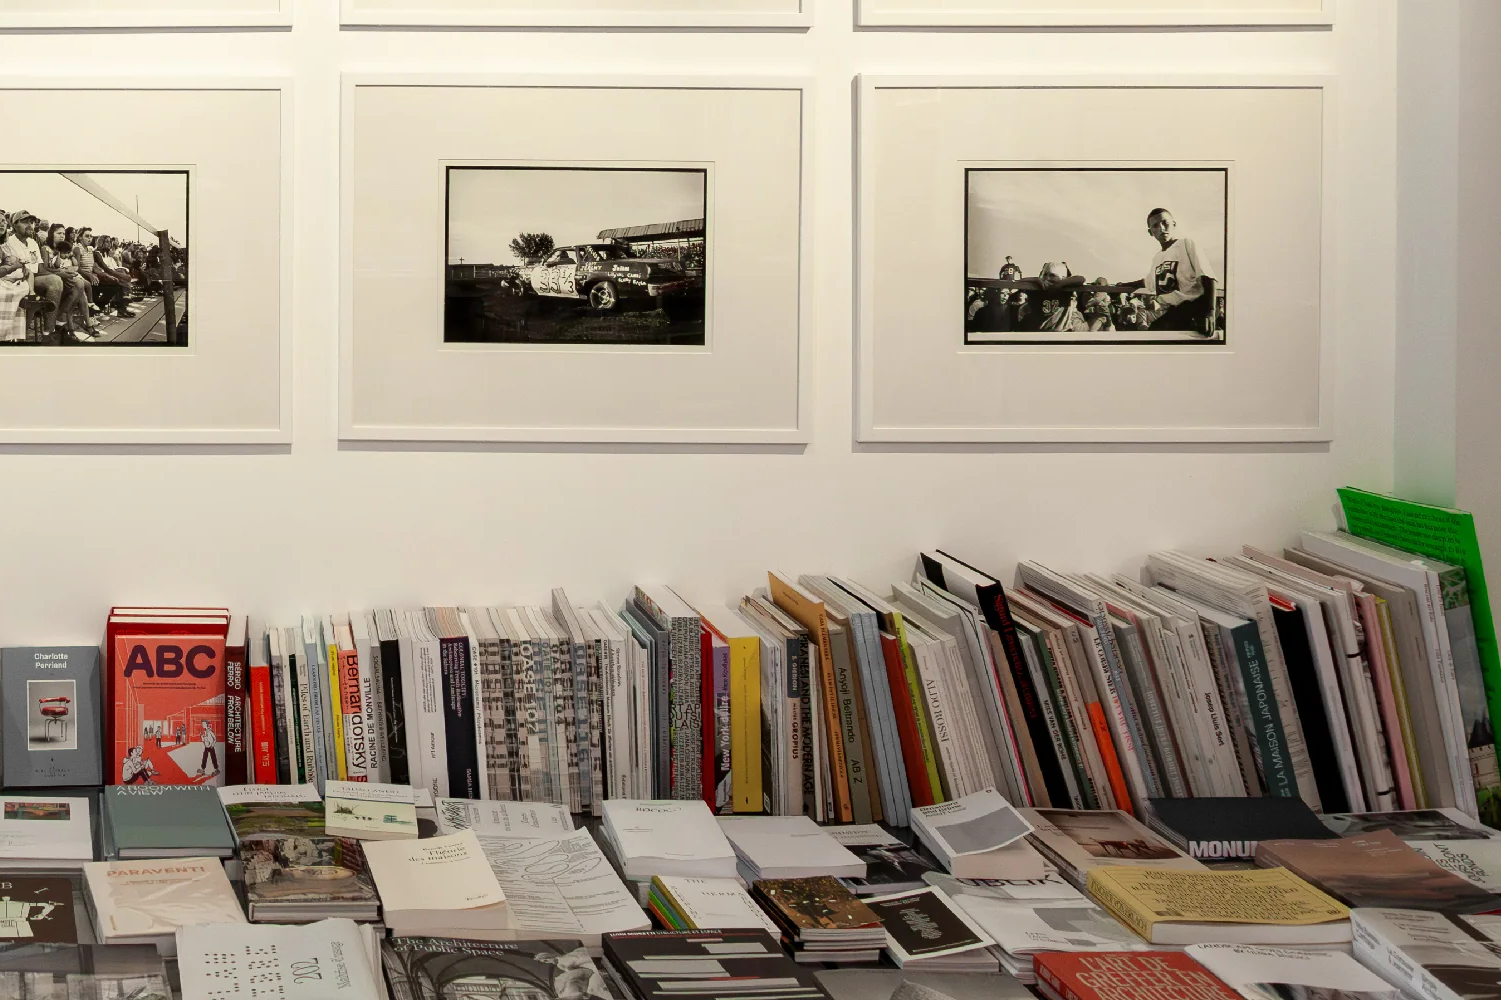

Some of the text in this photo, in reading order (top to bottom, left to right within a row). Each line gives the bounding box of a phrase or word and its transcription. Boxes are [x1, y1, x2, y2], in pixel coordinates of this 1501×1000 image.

[35, 661, 67, 669] Perriand
[123, 644, 216, 679] ABC
[300, 683, 308, 702] Piles
[1203, 692, 1214, 713] Josep
[800, 634, 814, 795] PIRANESI AND THE MODERN AGE
[925, 679, 949, 743] ALDO ROSSI
[364, 677, 378, 769] RACINE DE MONVILLE
[1248, 658, 1288, 791] LA MAISON JAPONAISE
[721, 729, 730, 750] York
[1046, 713, 1056, 729] VAN
[1054, 742, 1067, 761] ROHE
[720, 751, 730, 772] New
[107, 866, 206, 877] PARAVENTI
[391, 937, 519, 950] The Architecture
[394, 943, 505, 957] of Public Space
[1078, 956, 1178, 972] L'ART DE
[1076, 971, 1213, 987] GREFFER EN
[1094, 986, 1238, 1000] ARCHITECTURE
